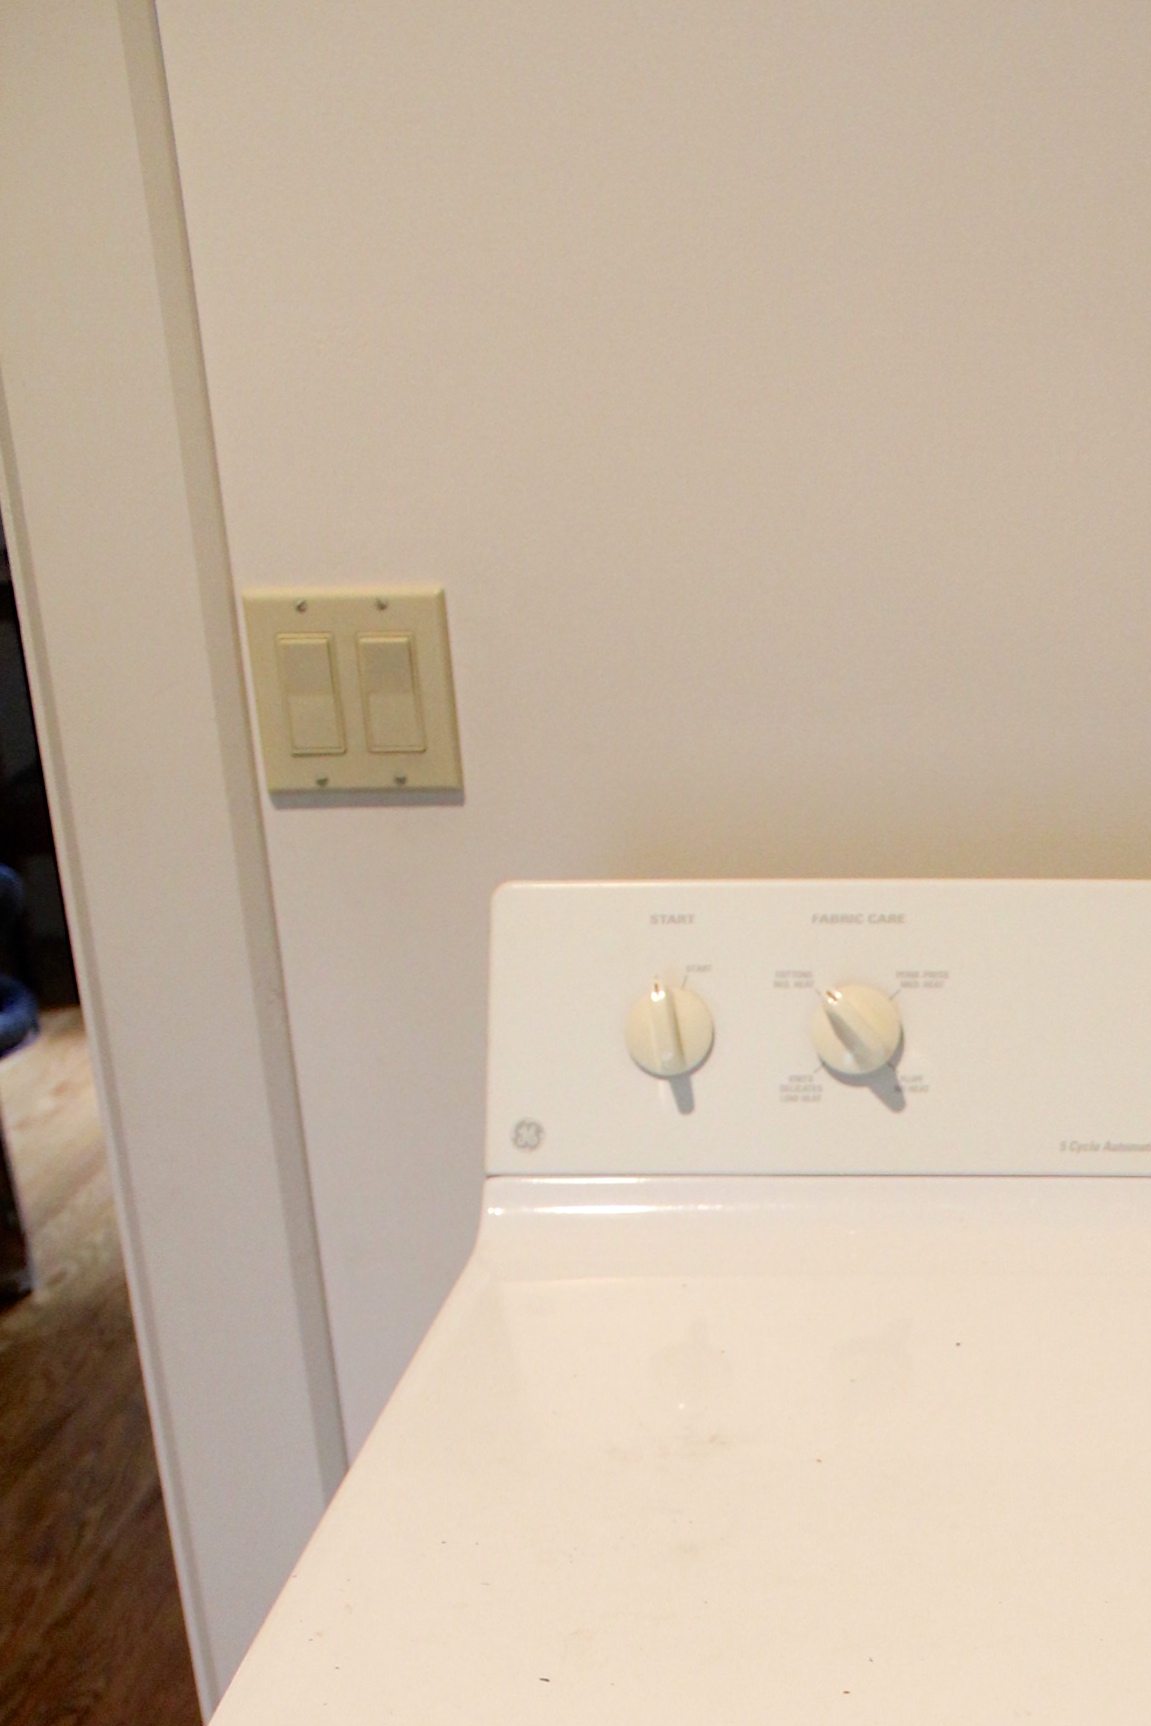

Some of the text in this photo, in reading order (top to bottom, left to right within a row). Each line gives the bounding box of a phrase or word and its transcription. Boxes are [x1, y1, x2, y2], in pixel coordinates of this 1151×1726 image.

[649, 913, 696, 925] START
[811, 913, 907, 925] FABRIC CARE
[1069, 1140, 1101, 1154] Cycle
